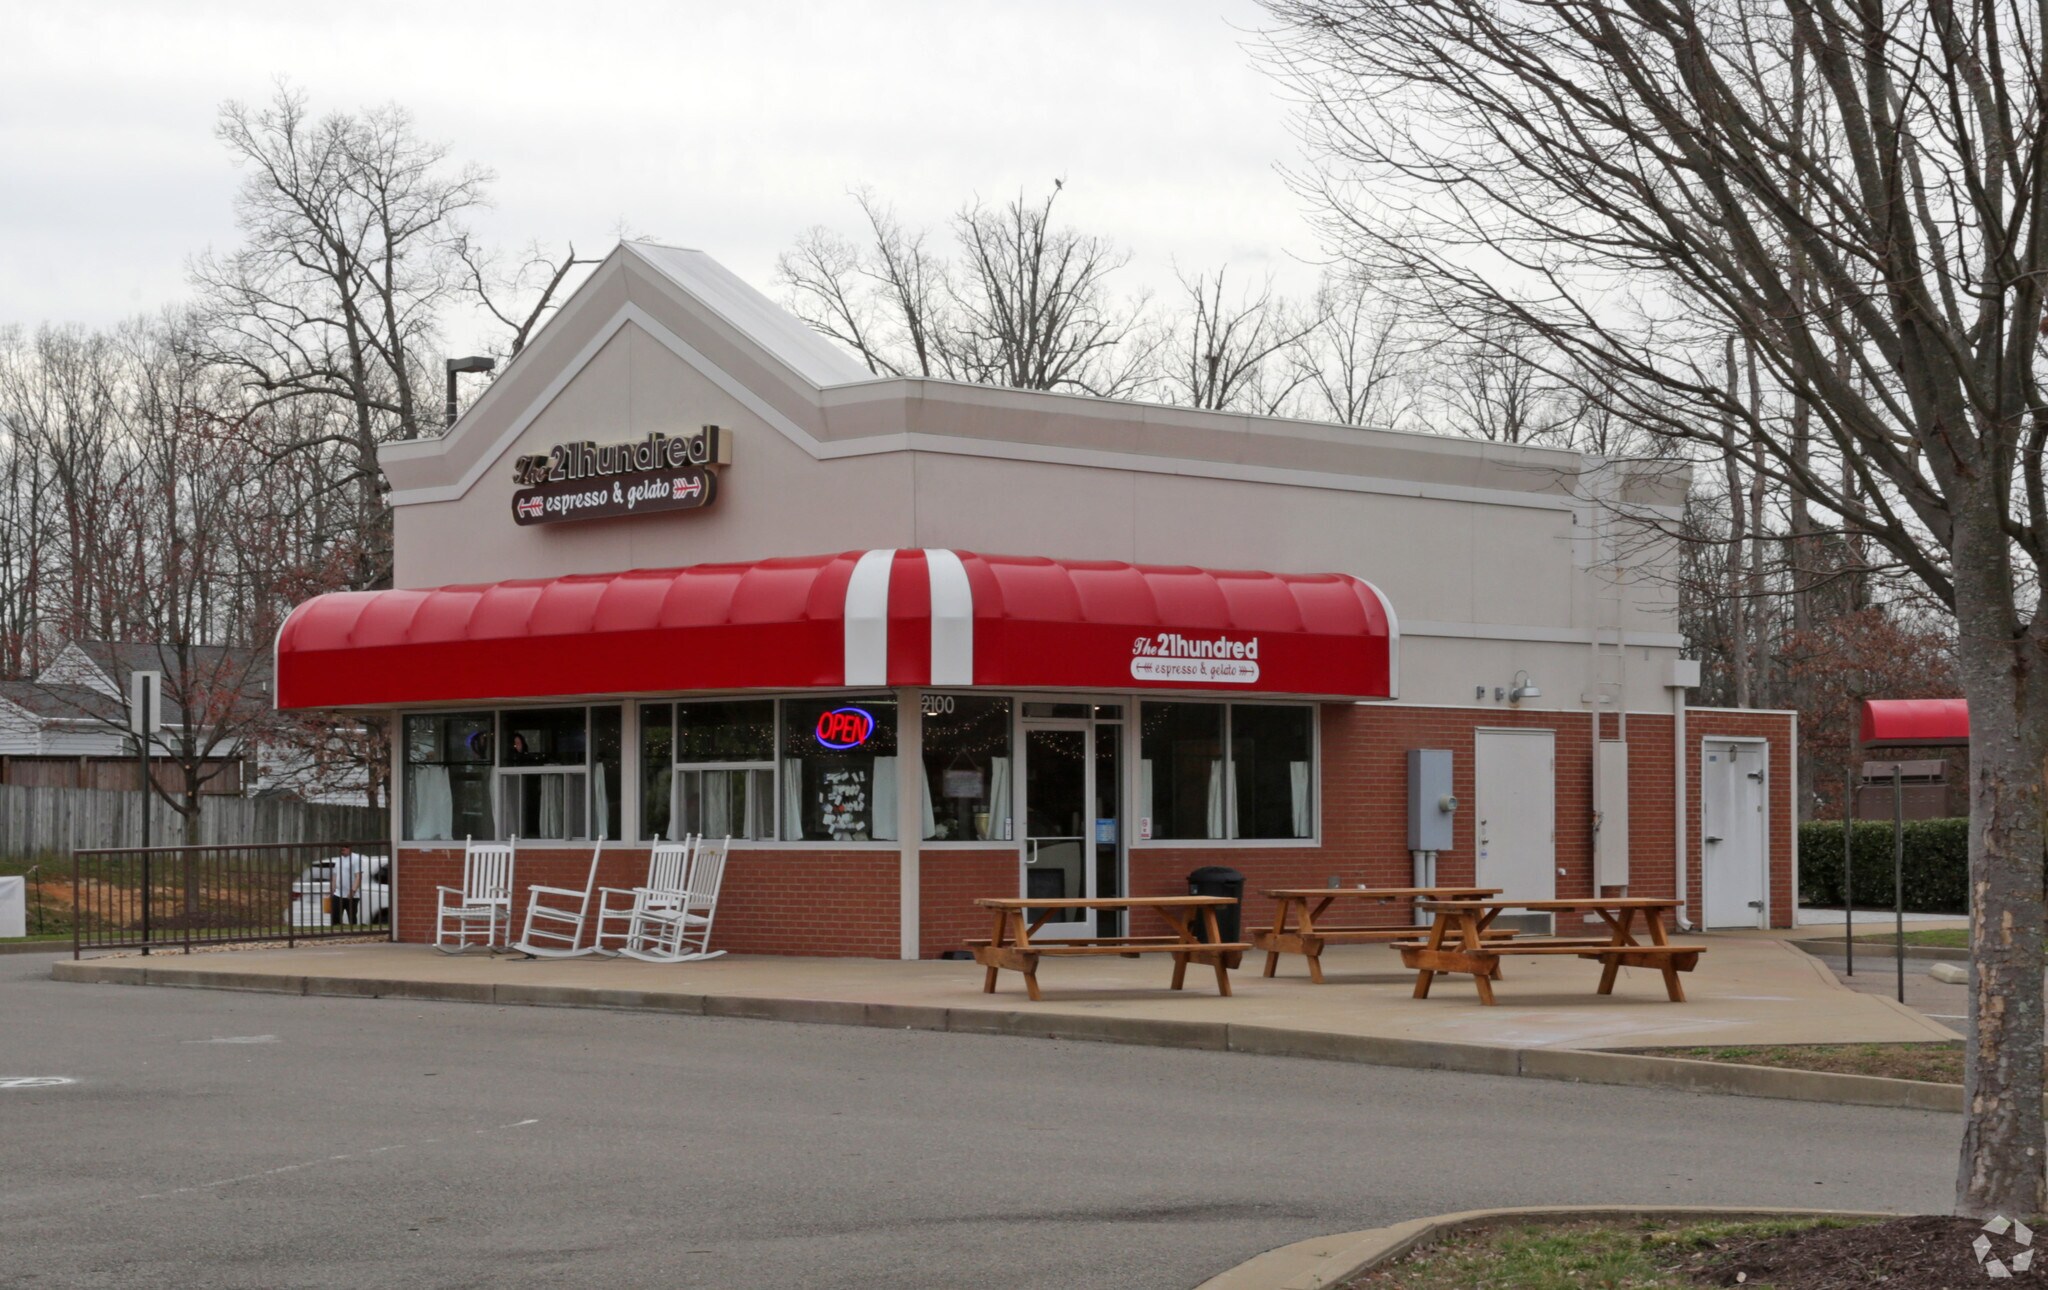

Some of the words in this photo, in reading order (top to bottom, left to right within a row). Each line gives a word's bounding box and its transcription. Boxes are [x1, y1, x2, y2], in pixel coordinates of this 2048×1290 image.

[513, 455, 548, 485] The
[548, 424, 716, 482] 21hundred
[546, 490, 608, 515] espresso
[613, 481, 624, 504] &
[627, 478, 670, 509] gelato
[1132, 637, 1157, 656] The
[1157, 633, 1258, 660] 21hundred
[1155, 662, 1198, 678] espresso
[1200, 662, 1207, 676] &
[1210, 664, 1237, 679] gelato
[921, 694, 955, 714] 2100
[817, 711, 868, 745] OPEN
